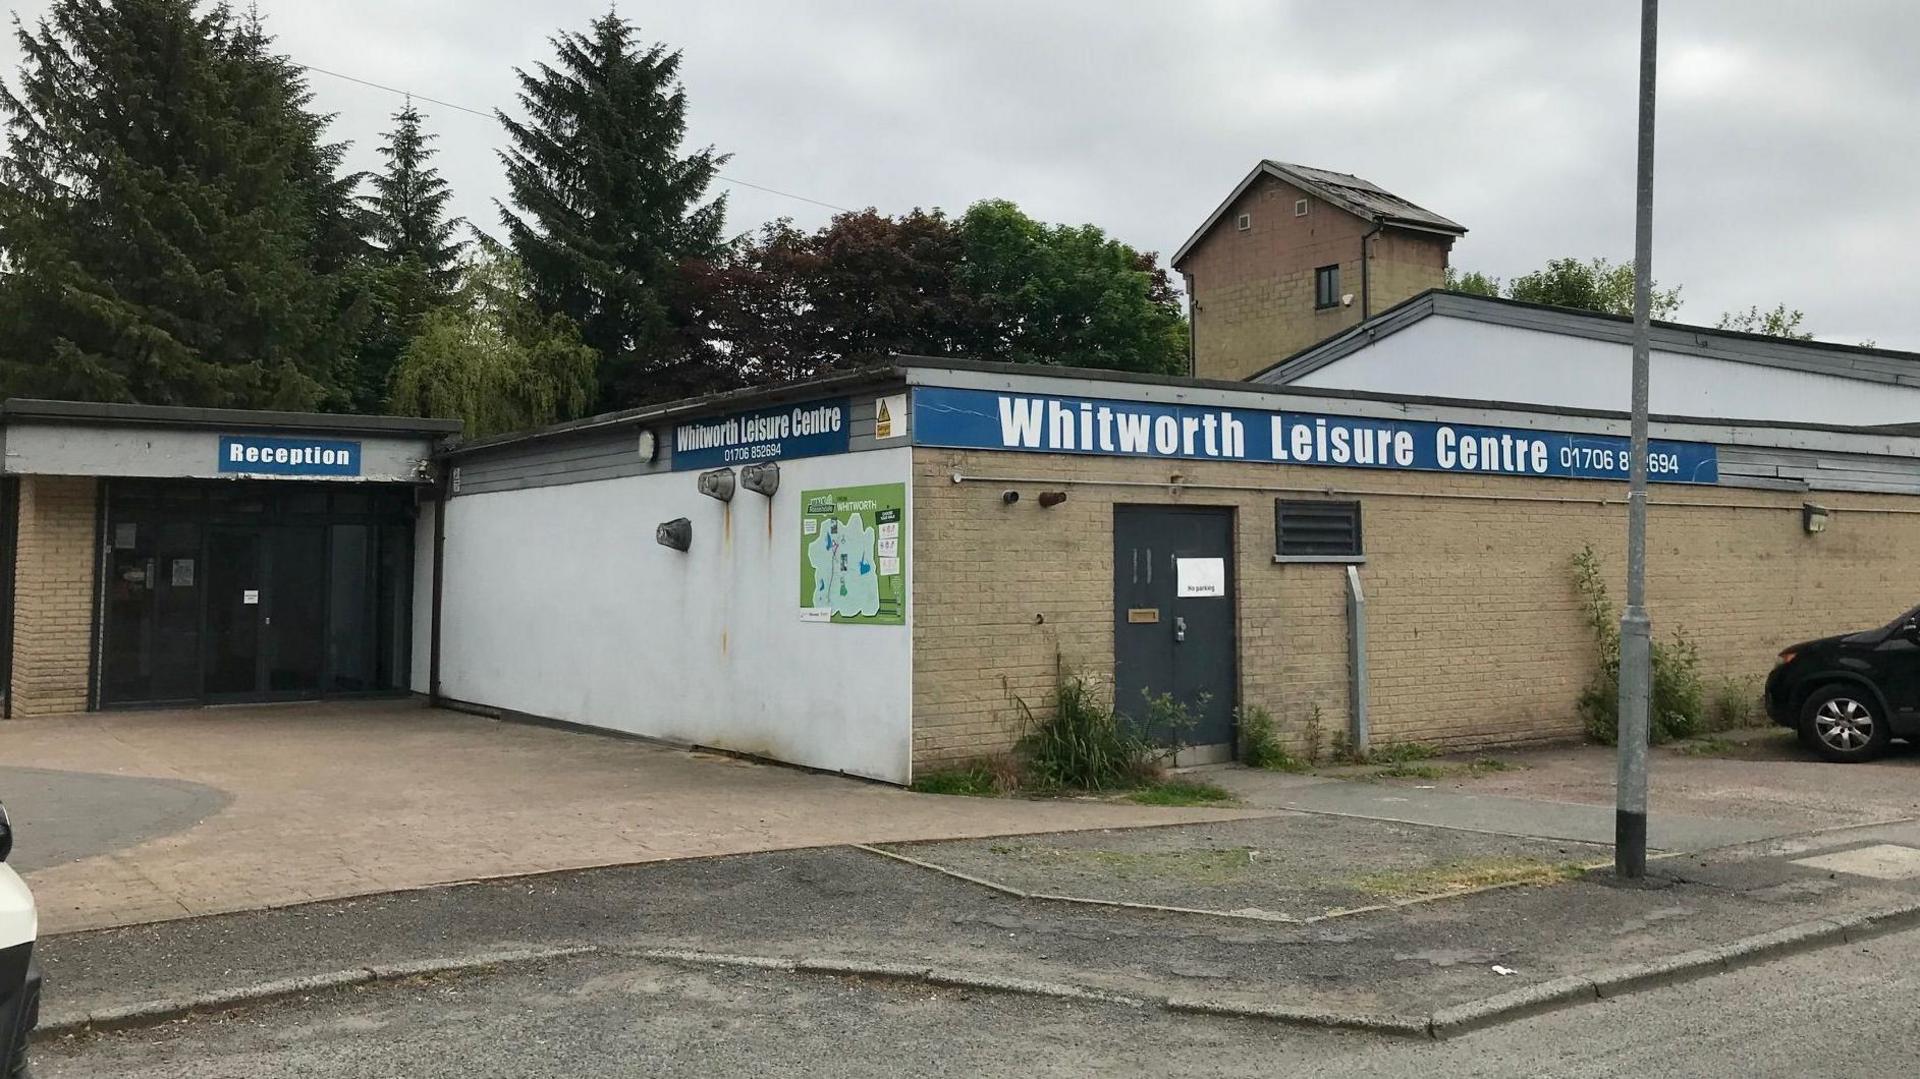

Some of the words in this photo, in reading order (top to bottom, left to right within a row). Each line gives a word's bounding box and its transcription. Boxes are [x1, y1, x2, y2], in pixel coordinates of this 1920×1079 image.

[677, 418, 738, 452] Whitworth
[741, 414, 789, 443] Leisure
[792, 406, 841, 437] Centre
[998, 396, 1245, 458] Whitworth
[1270, 415, 1414, 466] Leisure
[1436, 426, 1548, 473] Centre
[1560, 447, 1614, 470] 01706
[1619, 451, 1679, 474] 8694
[230, 443, 349, 465] Reception
[724, 448, 749, 462] 01706
[751, 443, 781, 459] 852694
[837, 500, 876, 512] WHITWORTH
